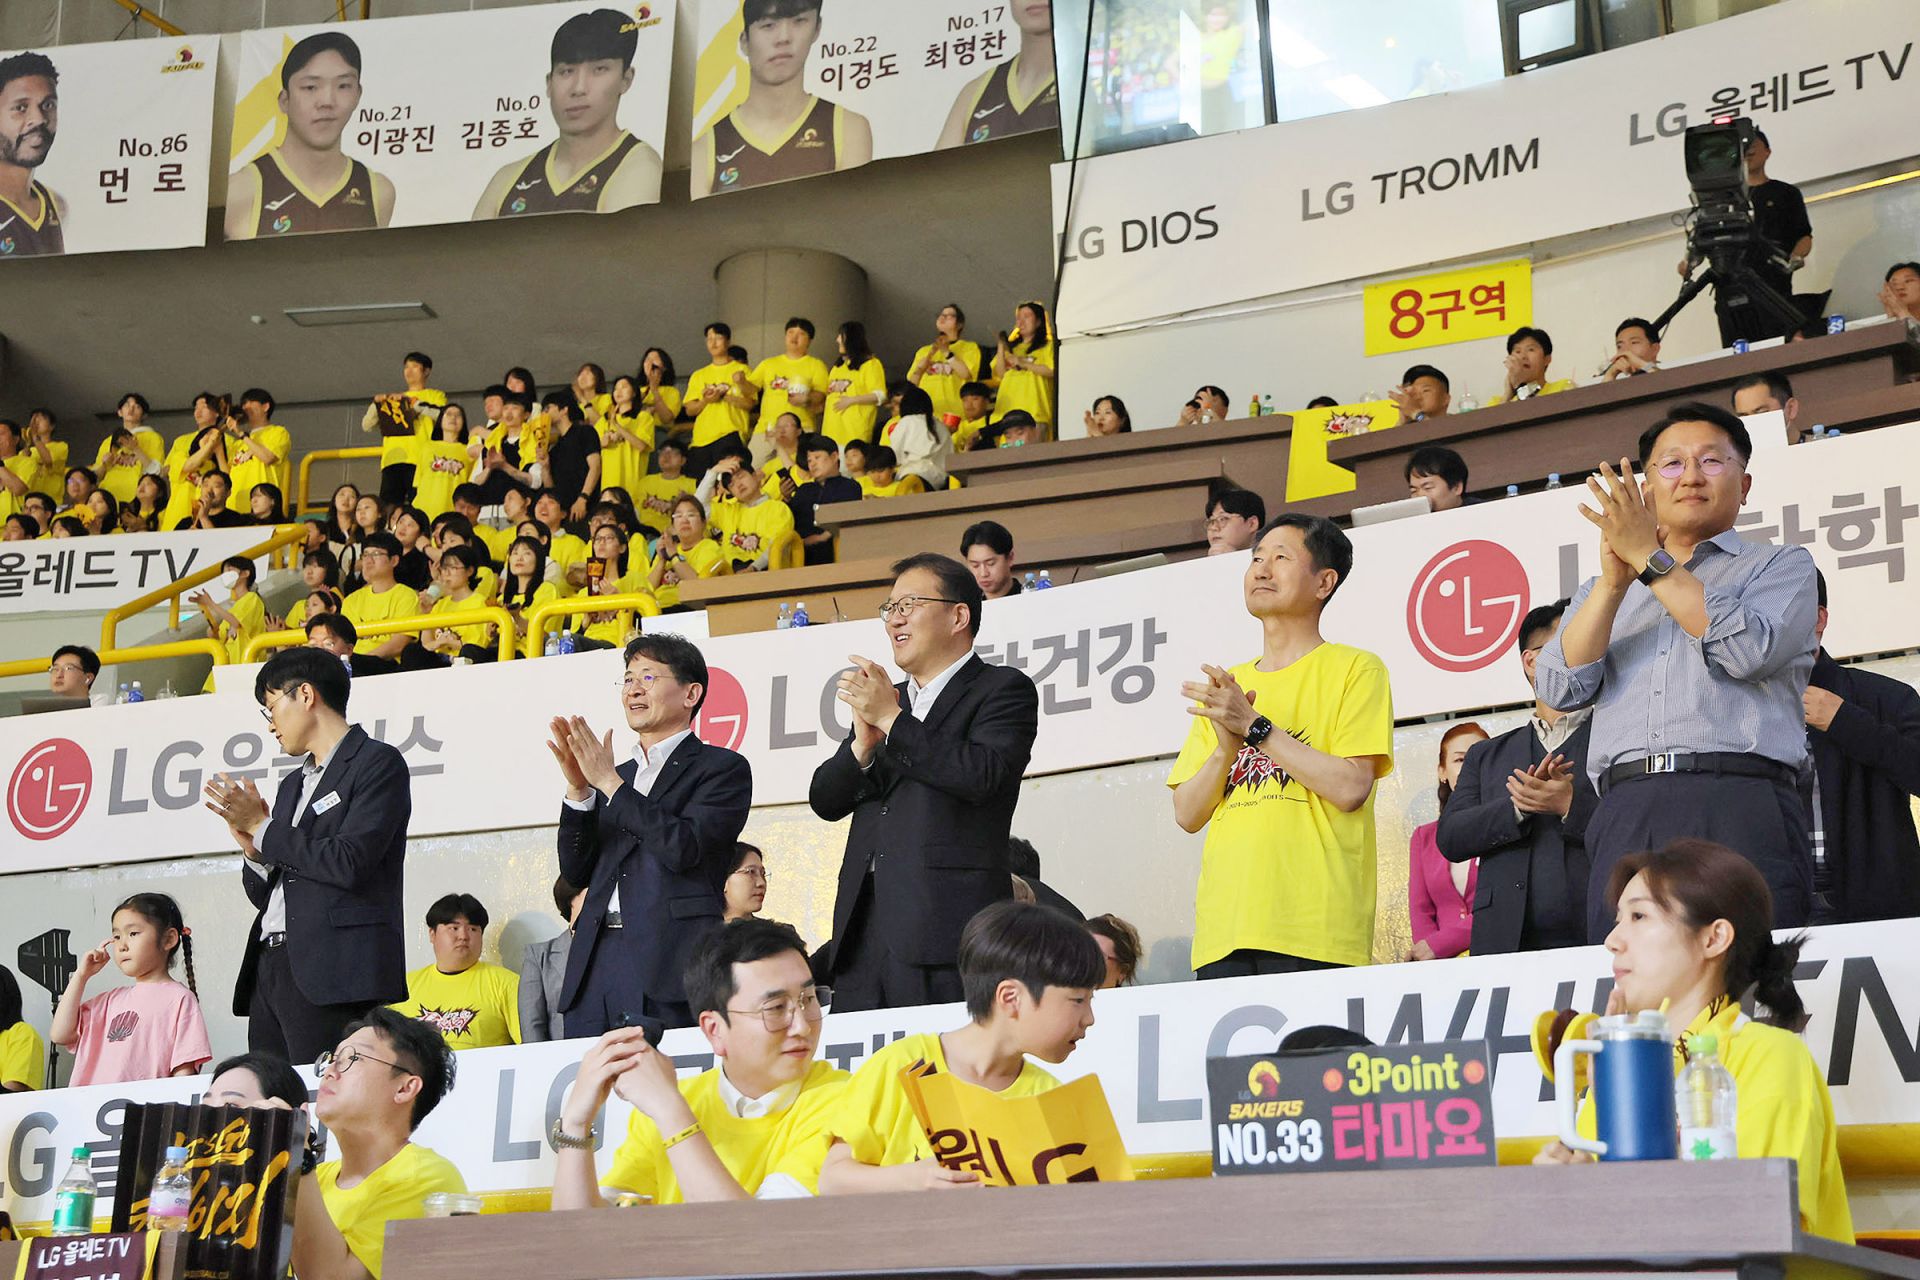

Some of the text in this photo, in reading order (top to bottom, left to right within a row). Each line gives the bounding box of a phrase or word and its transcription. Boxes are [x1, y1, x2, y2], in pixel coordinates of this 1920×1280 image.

[948, 7, 1005, 32] No.17
[821, 36, 877, 59] No.22
[924, 30, 1007, 69] 최형찬
[820, 53, 900, 91] 이경도
[497, 96, 541, 112] No.0
[1629, 42, 1913, 146] LG 올레드 TV
[359, 106, 412, 123] No.21
[461, 117, 540, 149] 김종호
[119, 134, 188, 157] No.86
[357, 125, 435, 155] 이광진
[1302, 137, 1539, 222] LG TROMM
[1057, 204, 1219, 265] LG DIOS
[1389, 280, 1506, 339] 8구역
[0, 548, 200, 598] 올레드 TV
[1347, 1052, 1461, 1096] 3Point
[1228, 1100, 1304, 1120] SAKERS
[1217, 1118, 1324, 1166] NO.33
[1331, 1097, 1487, 1163] 타마요
[0, 1110, 59, 1199] G
[37, 1237, 131, 1269] LG 올레드 TV
